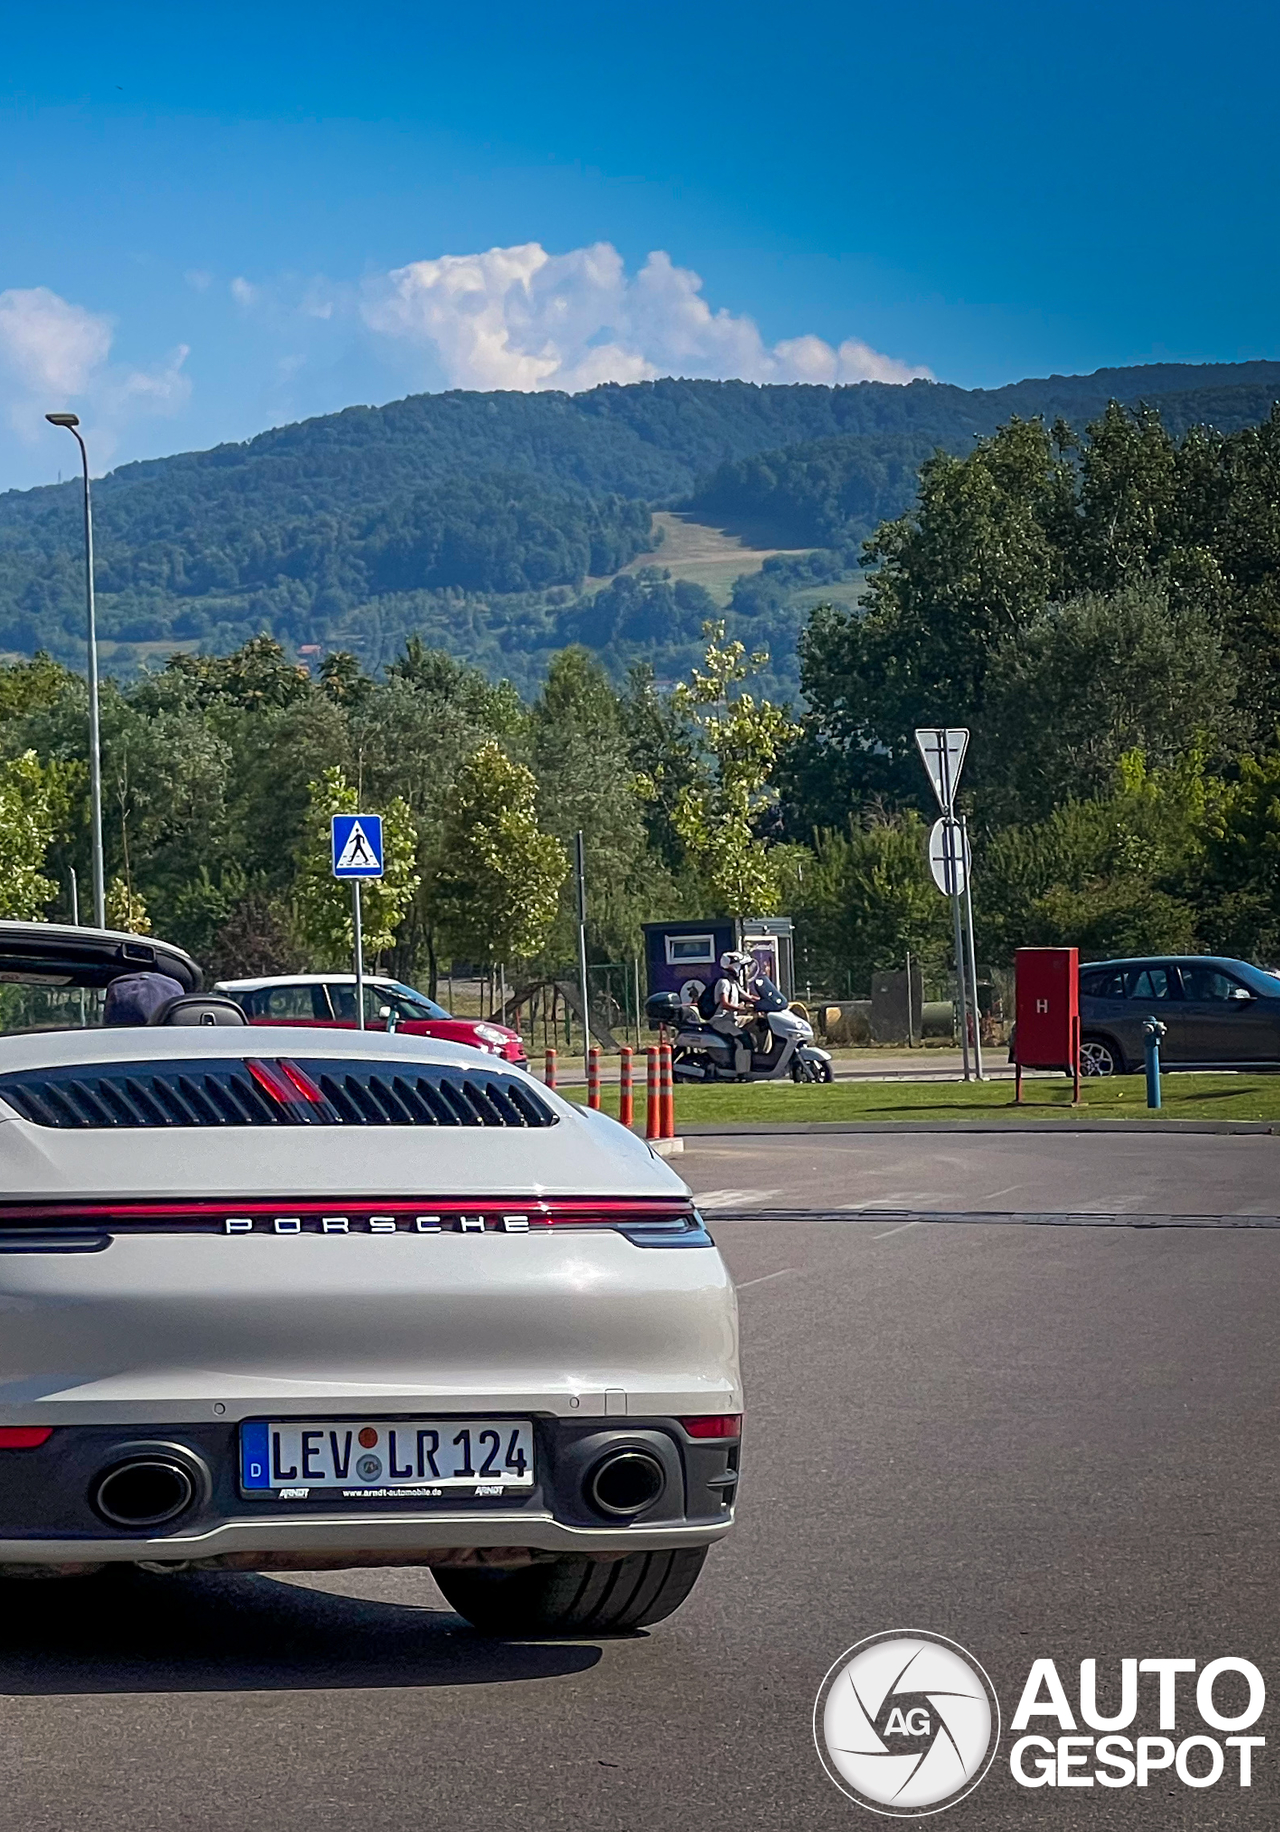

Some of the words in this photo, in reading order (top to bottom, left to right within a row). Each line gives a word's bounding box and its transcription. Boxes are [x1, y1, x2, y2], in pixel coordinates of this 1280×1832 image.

[1036, 999, 1048, 1014] H
[226, 1216, 530, 1234] PORSCHE
[272, 1430, 353, 1480] LEV
[388, 1429, 440, 1478] LR
[452, 1429, 528, 1478] 124
[250, 1463, 261, 1477] D
[279, 1488, 309, 1499] ARNDT
[475, 1486, 505, 1497] ARNDT
